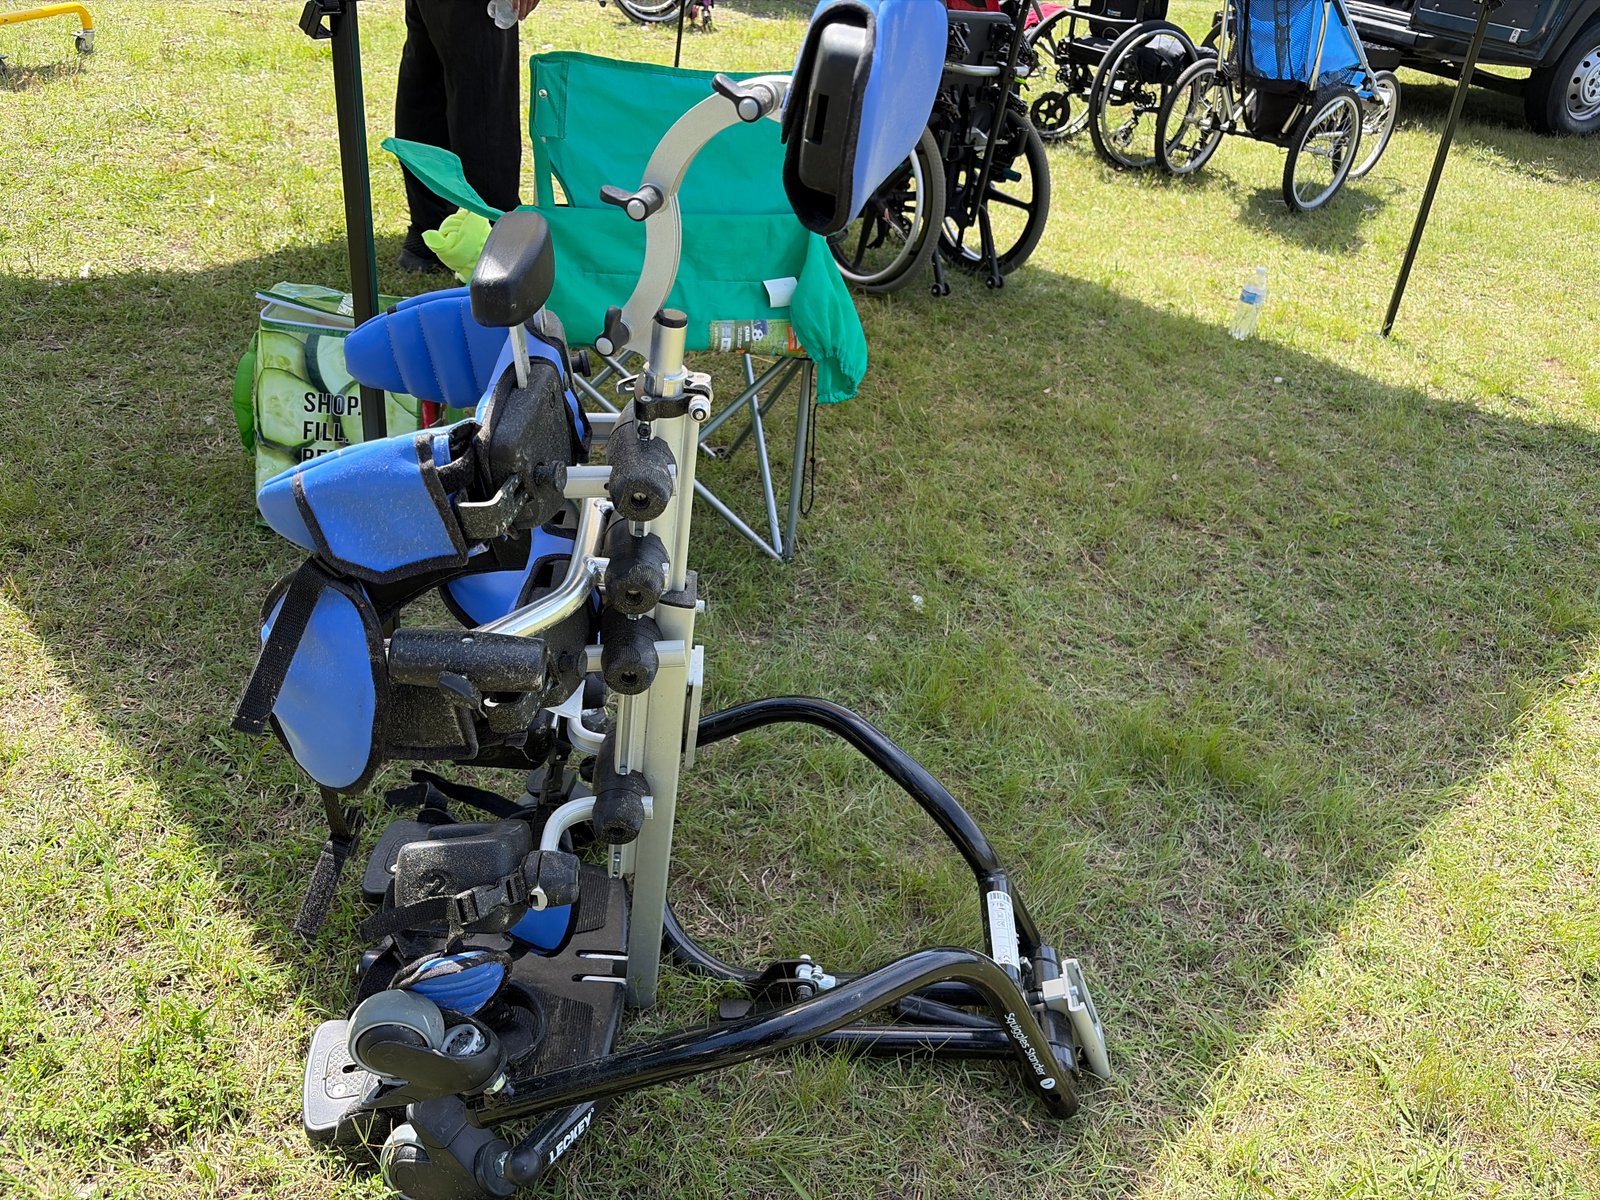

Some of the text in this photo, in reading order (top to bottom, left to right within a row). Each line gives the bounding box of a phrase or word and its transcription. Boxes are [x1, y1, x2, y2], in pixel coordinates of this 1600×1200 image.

[303, 392, 361, 416] SHOP.
[303, 420, 349, 442] FILL.
[1004, 1012, 1030, 1049] Squiggles
[1024, 1047, 1046, 1076] Stander
